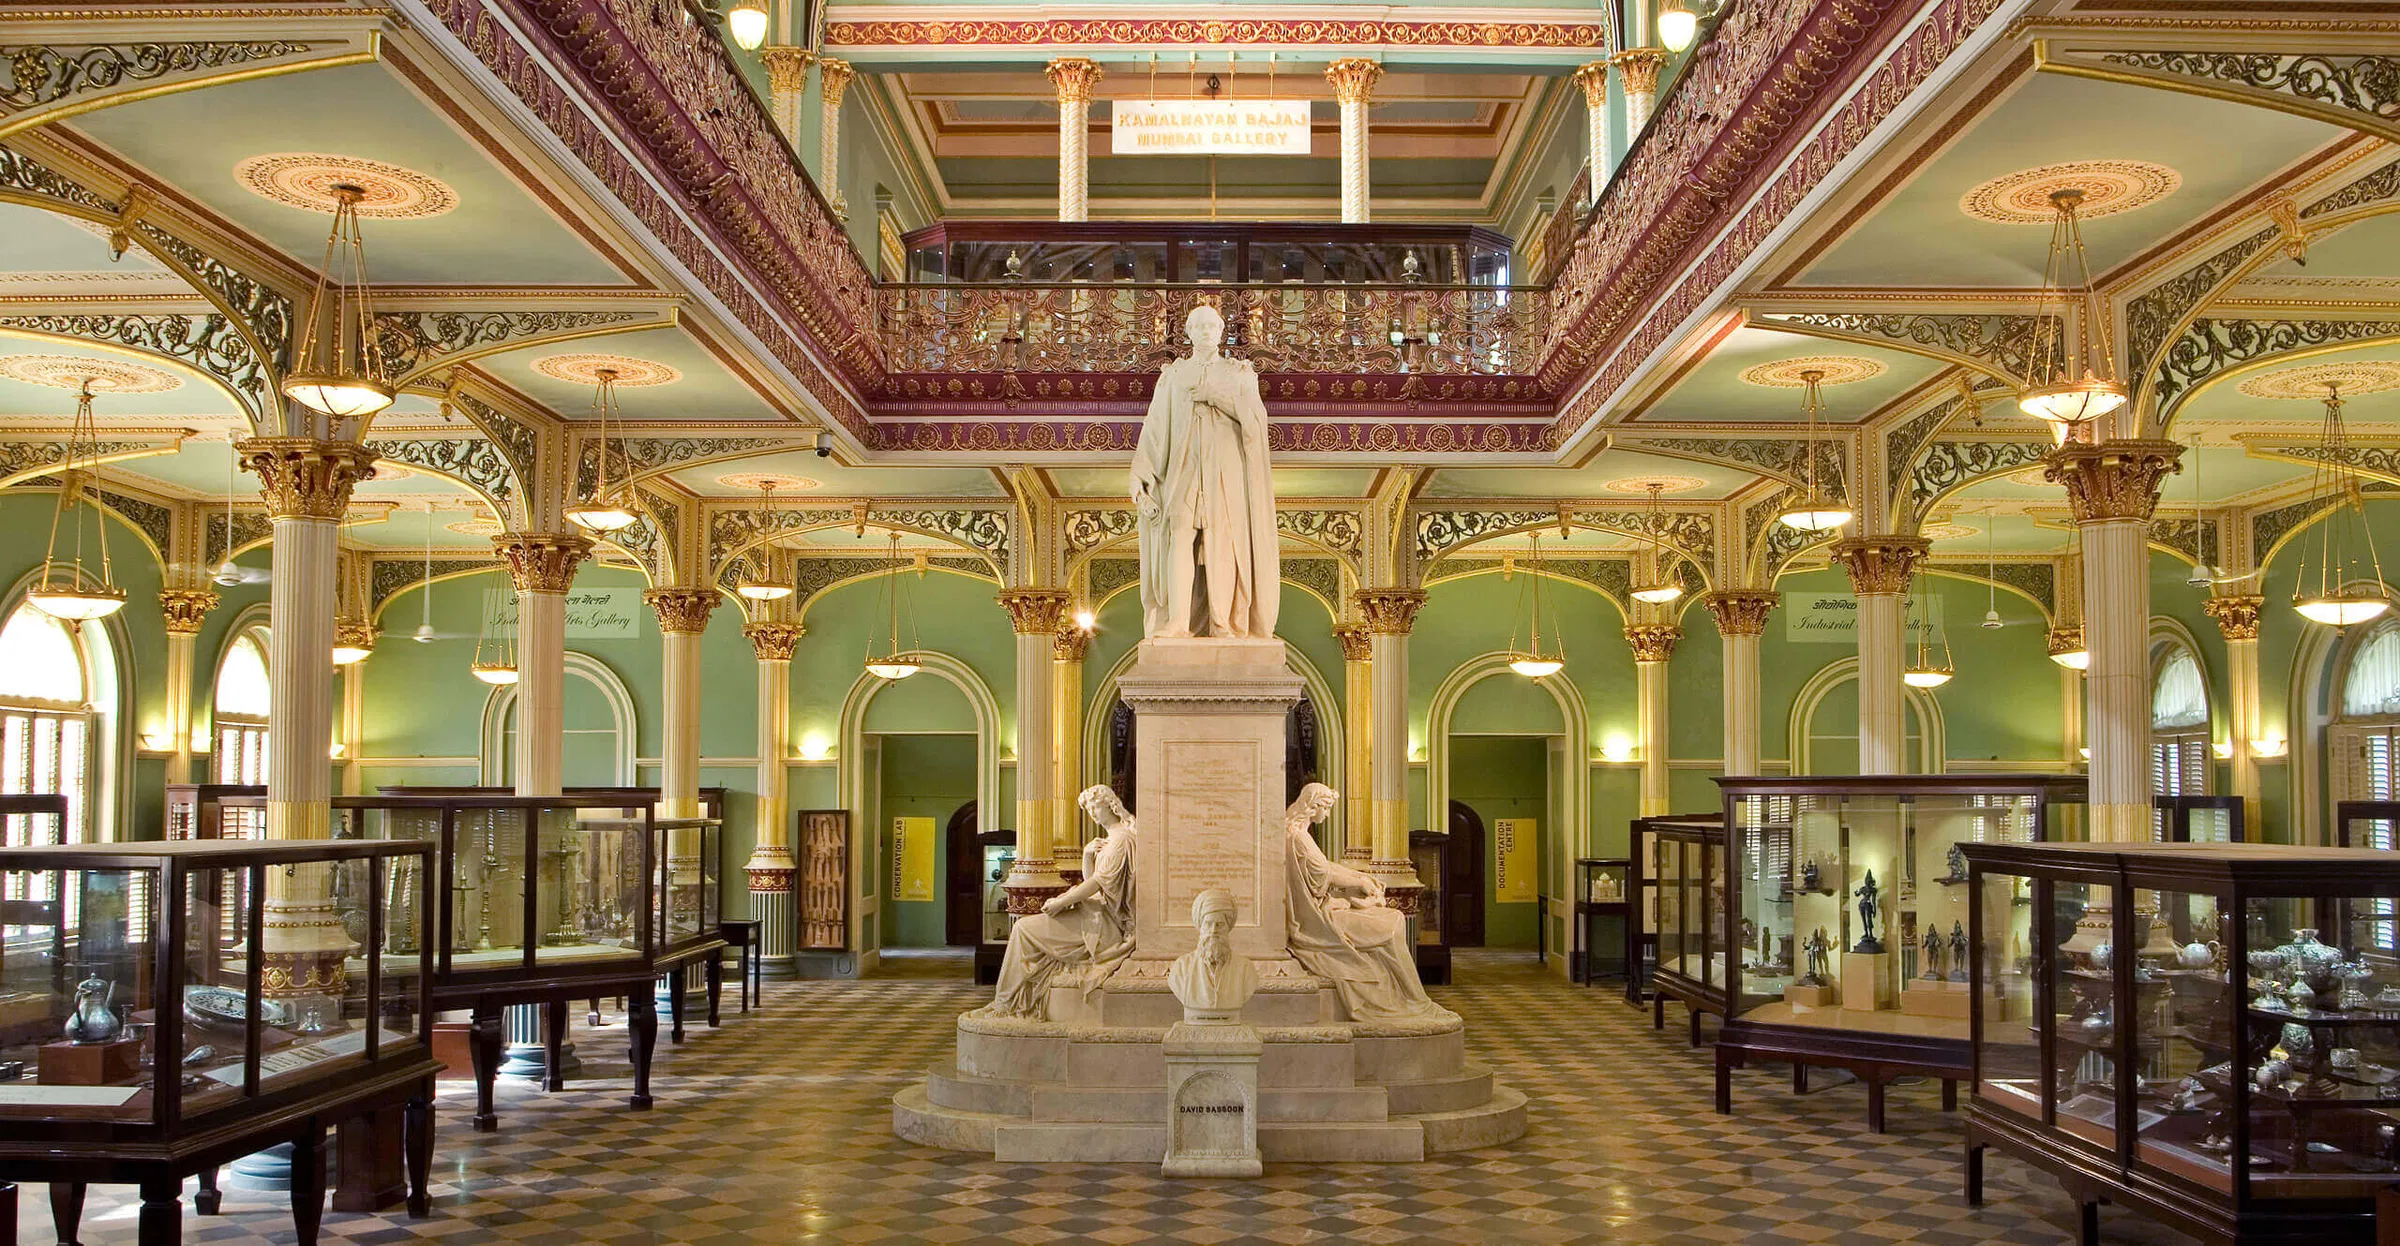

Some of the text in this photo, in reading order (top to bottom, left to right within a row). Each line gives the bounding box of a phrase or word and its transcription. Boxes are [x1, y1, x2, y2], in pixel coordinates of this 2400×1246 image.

[1119, 113, 1307, 127] KAMALNAYAN BAJAJ
[1137, 132, 1288, 146] MUMBAI GALLERY
[585, 610, 631, 629] Gallery
[1793, 615, 1855, 630] Industrial
[894, 838, 902, 898] CONSERVATION
[1206, 1105, 1244, 1113] SASSOON
